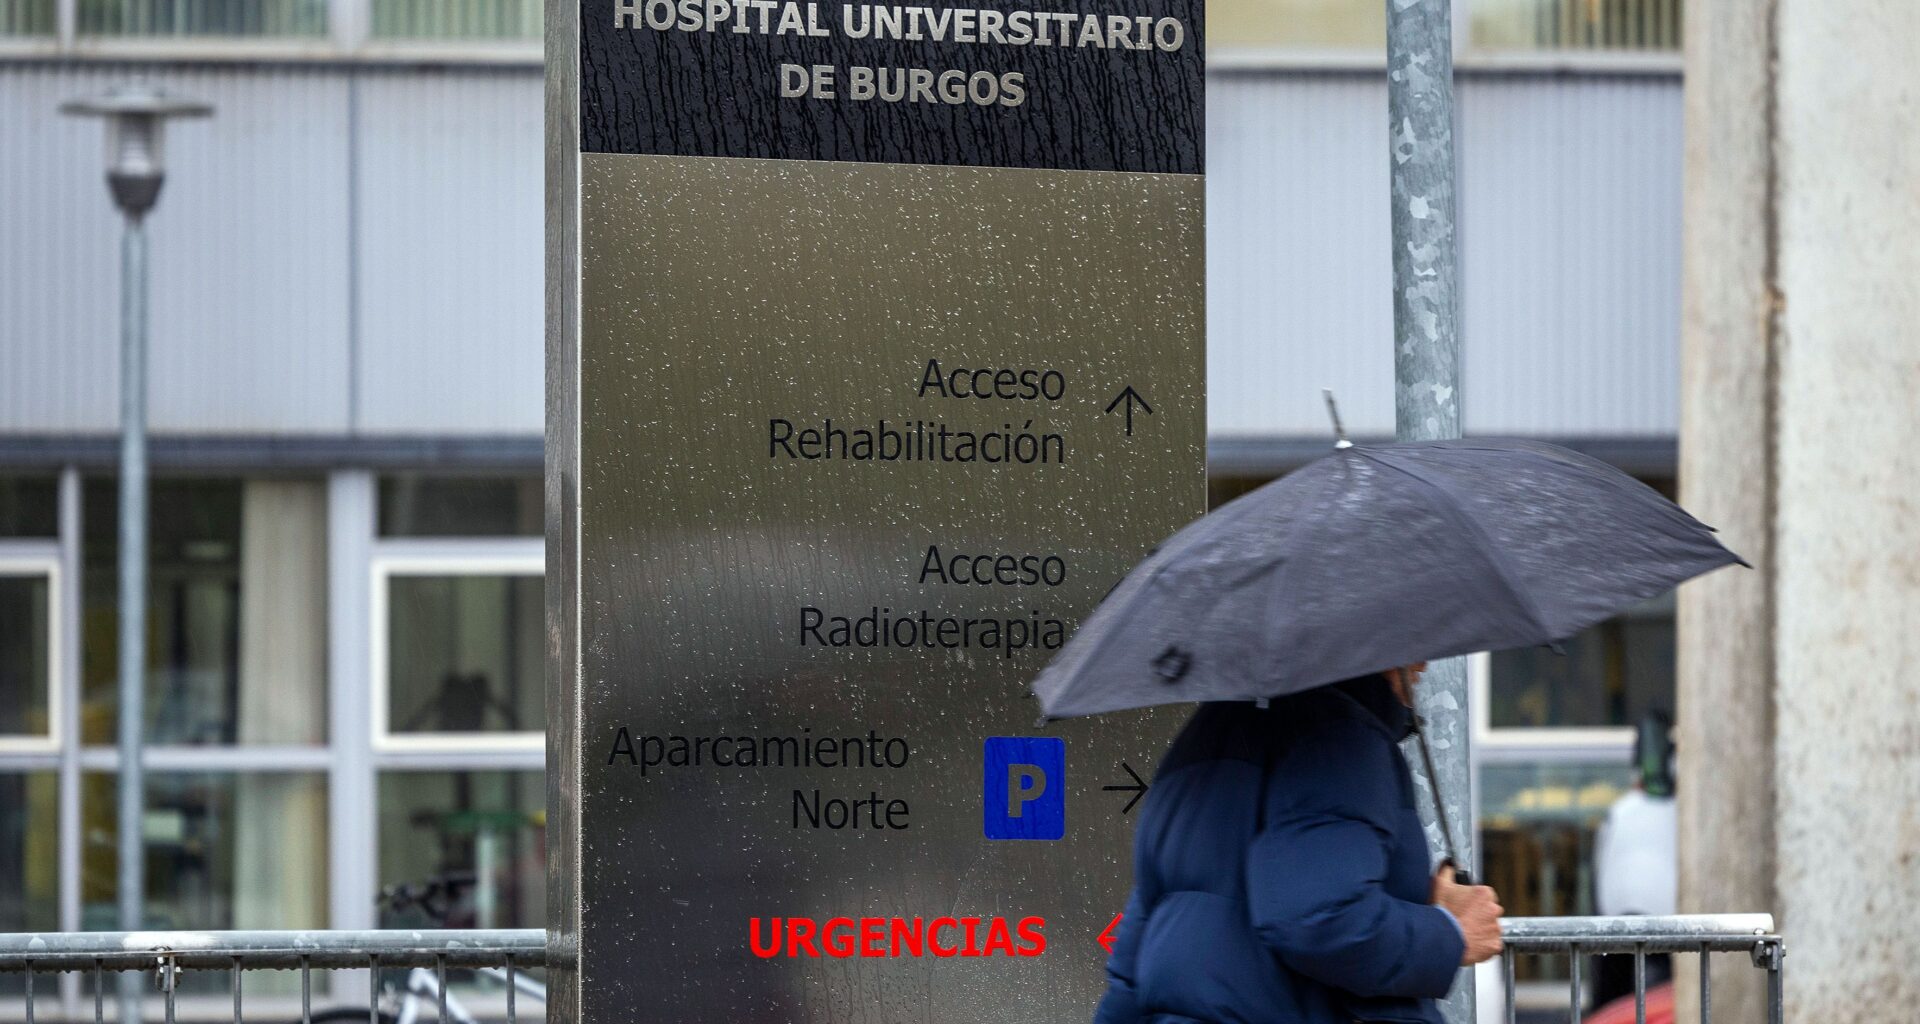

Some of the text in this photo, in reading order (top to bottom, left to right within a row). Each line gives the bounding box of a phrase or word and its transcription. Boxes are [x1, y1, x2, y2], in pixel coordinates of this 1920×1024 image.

[613, 0, 1184, 52] HOSPITAL UNIVERSITARIO
[781, 65, 1026, 107] DE BURGOS
[919, 359, 1065, 400] Acceso
[769, 418, 1064, 464] Rehabilitación
[919, 545, 1066, 587] Acceso
[800, 607, 1065, 658] Radioterapia
[607, 727, 909, 776] Aparcamiento
[792, 790, 909, 830] Norte
[1007, 764, 1046, 817] P
[749, 917, 1047, 957] URGENCIAS
